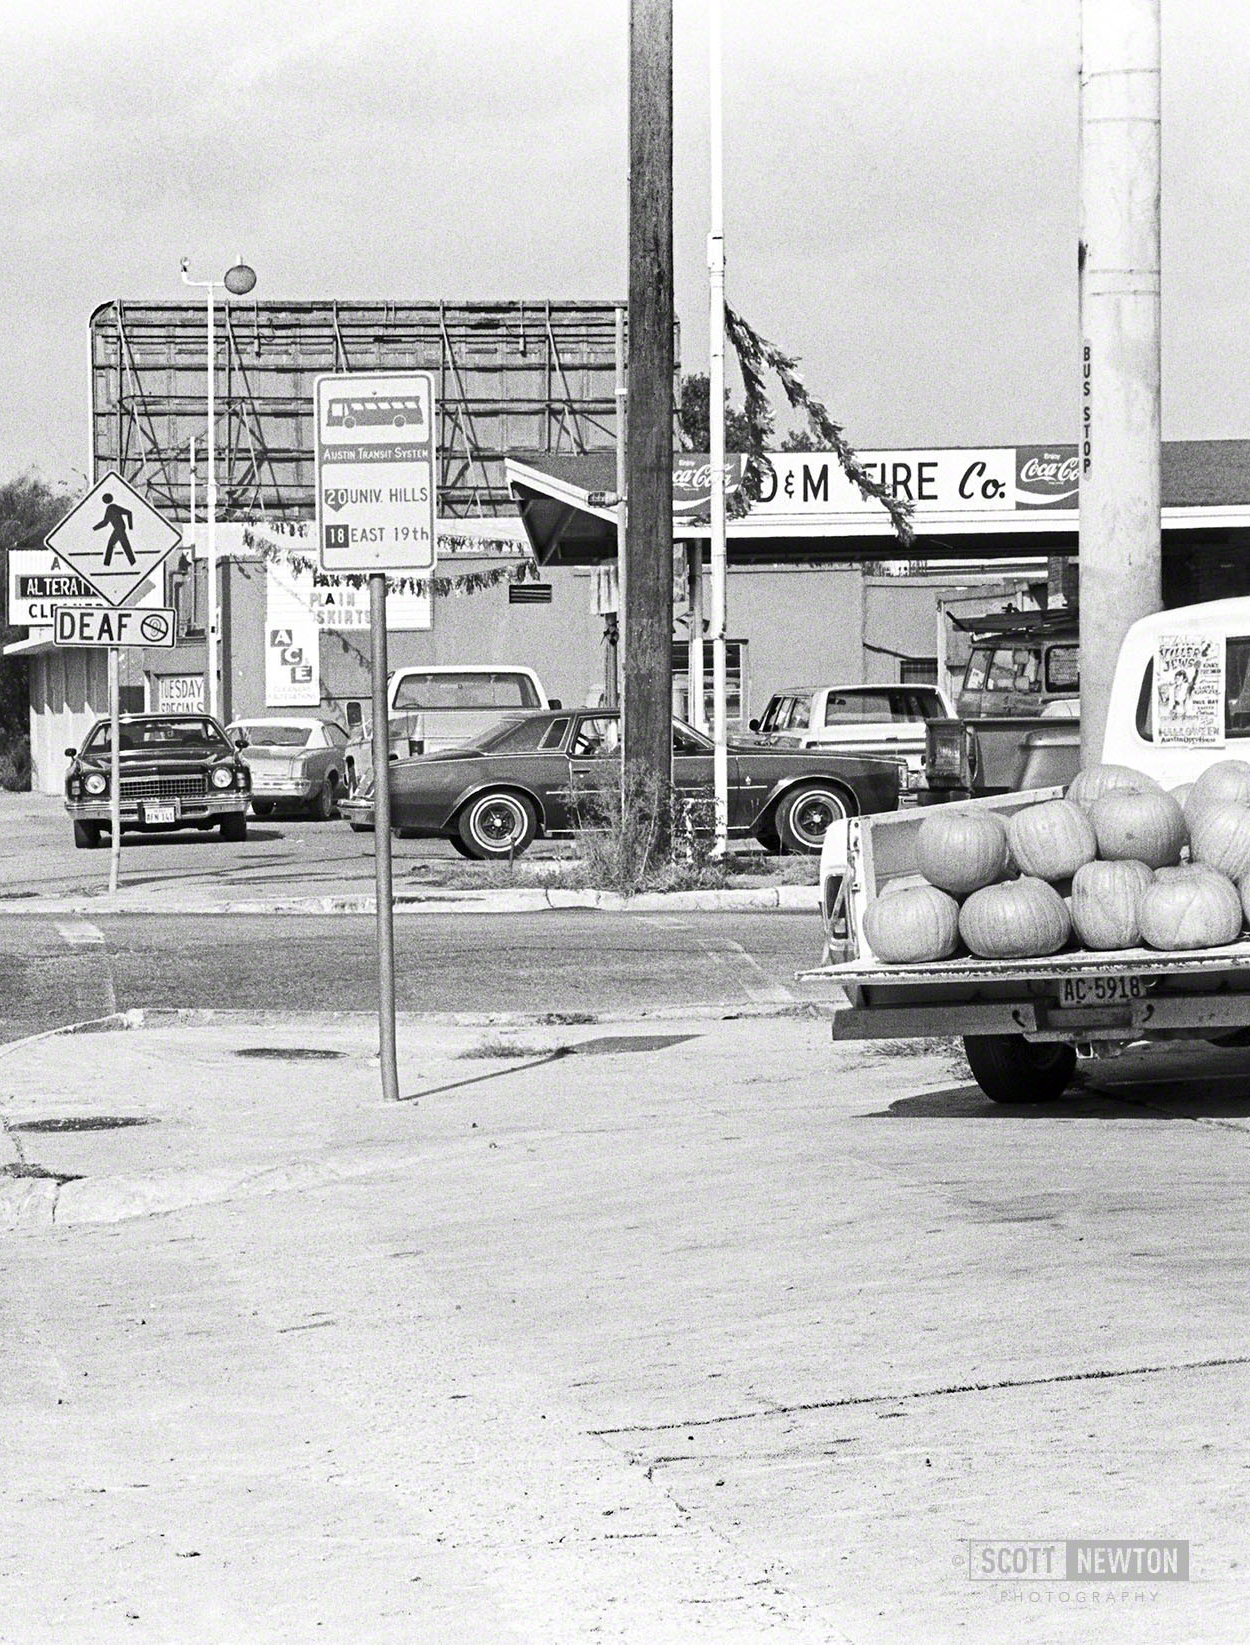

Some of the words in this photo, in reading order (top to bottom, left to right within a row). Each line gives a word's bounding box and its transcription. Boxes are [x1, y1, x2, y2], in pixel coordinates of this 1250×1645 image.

[1083, 346, 1091, 396] BUS
[1083, 407, 1091, 473] STOP
[323, 449, 355, 460] AUSTIN
[358, 447, 392, 459] TRANSIT
[394, 447, 429, 459] SYSTEM
[958, 461, 1006, 499] Co.
[1020, 457, 1079, 483] Coca-Co
[327, 489, 347, 505] 20
[349, 488, 383, 504] UNIV.
[389, 487, 428, 503] HILLS
[330, 528, 345, 544] 18
[351, 527, 386, 542] EAST
[394, 526, 429, 542] 19th
[26, 578, 96, 596] ALTERAT
[59, 611, 132, 642] DEAF
[160, 679, 204, 699] TUESDAY
